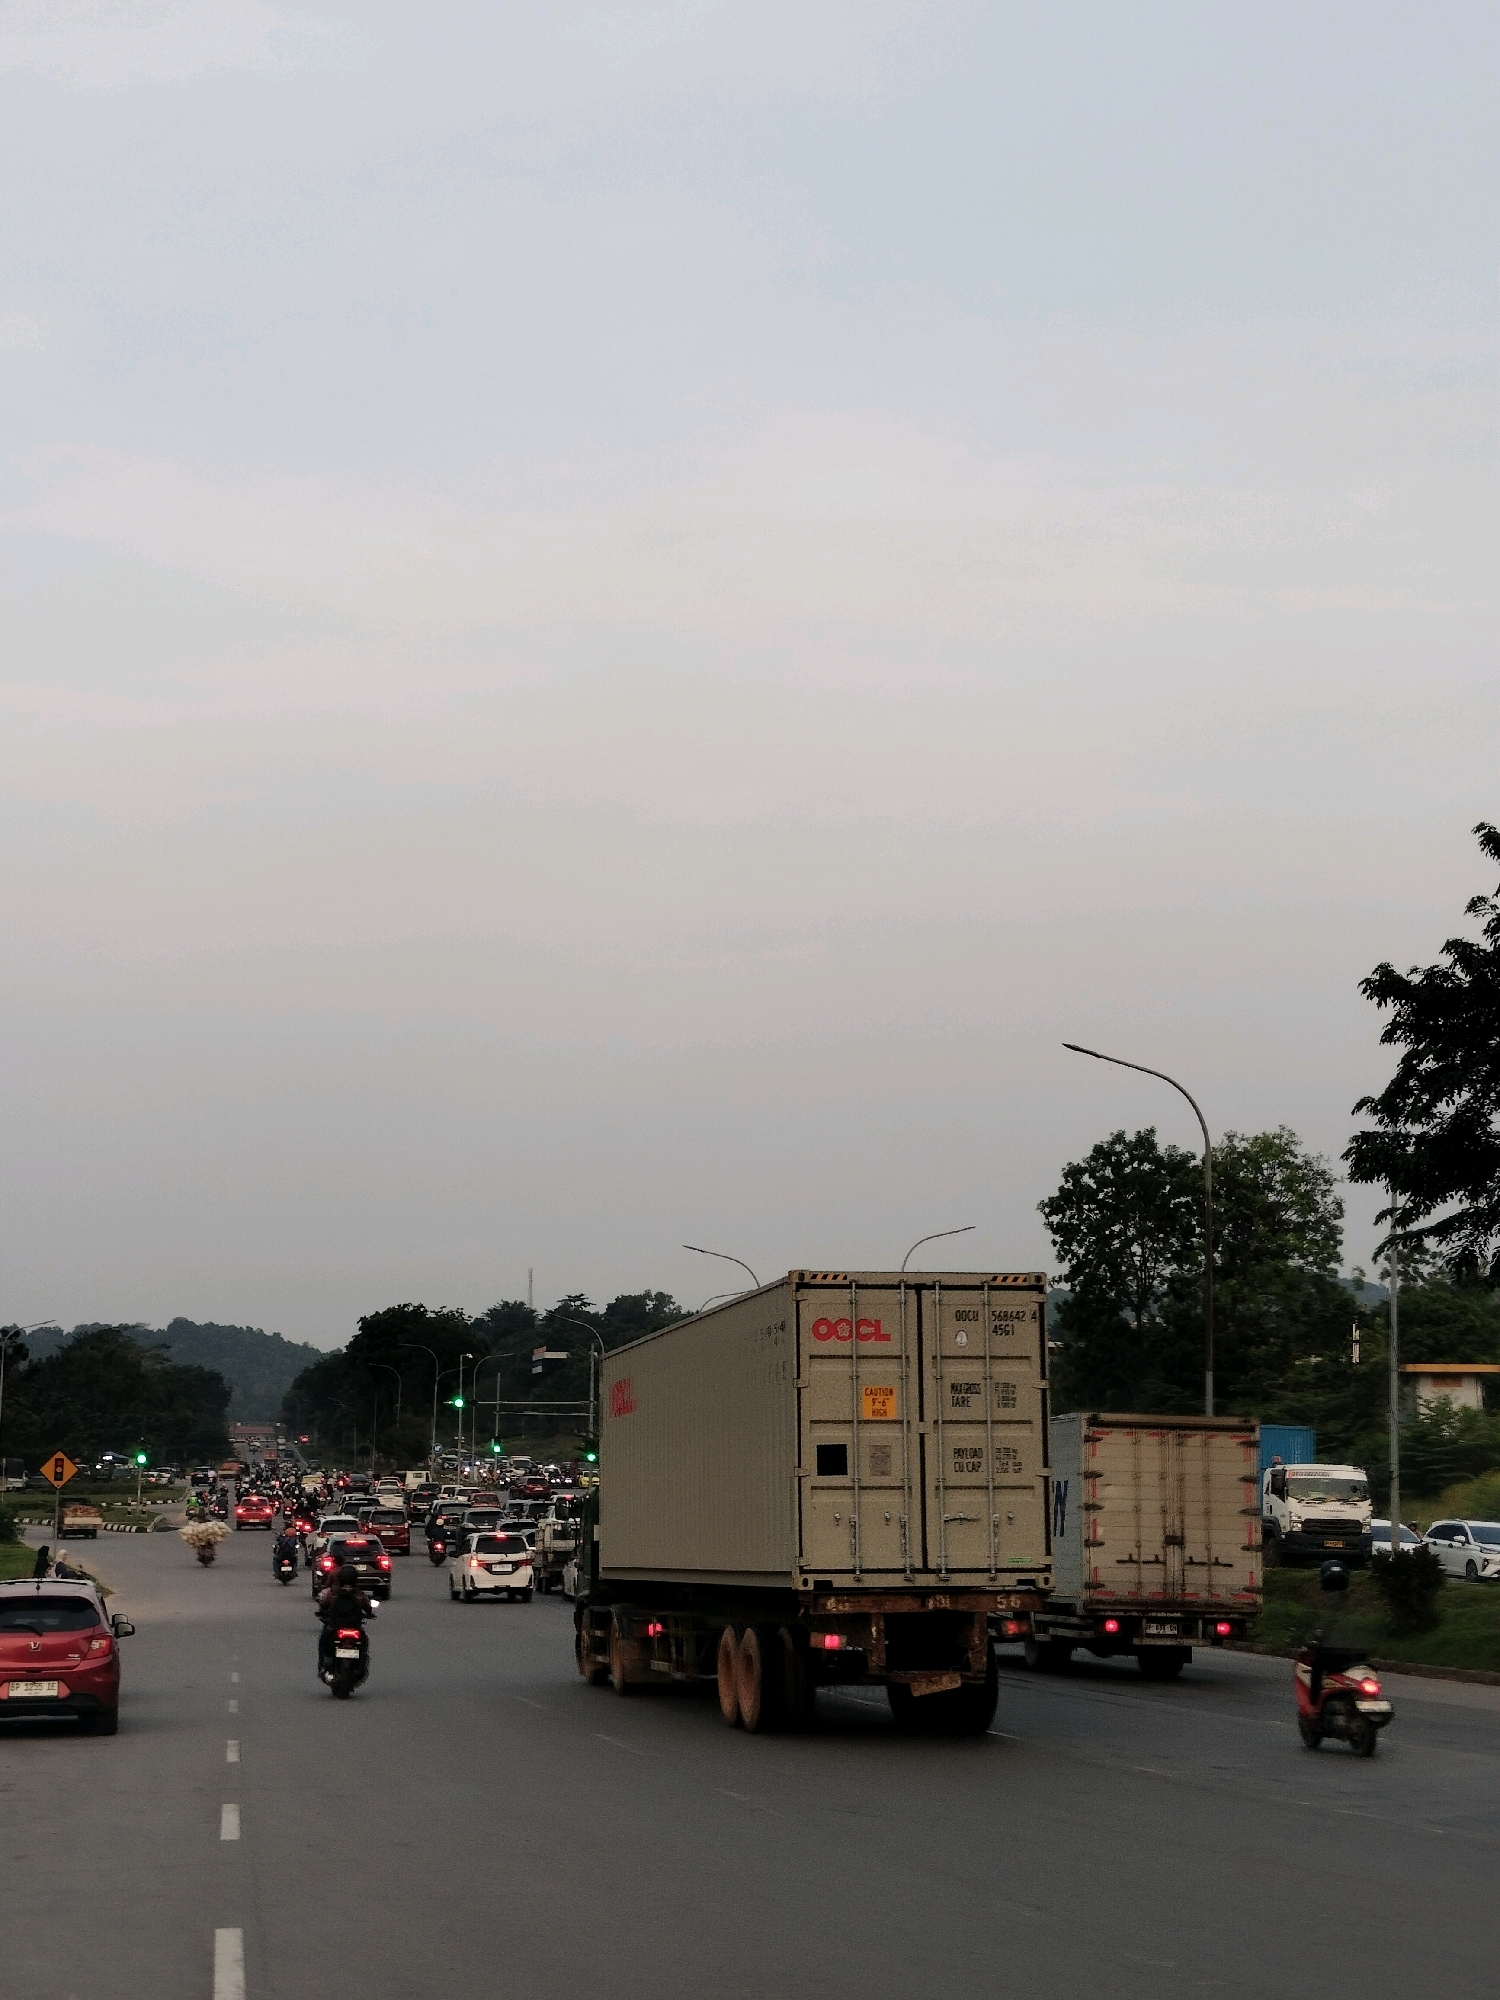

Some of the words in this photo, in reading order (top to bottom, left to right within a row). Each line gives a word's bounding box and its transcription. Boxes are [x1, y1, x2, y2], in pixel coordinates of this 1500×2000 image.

[991, 1310, 1026, 1321] 568642
[812, 1318, 891, 1342] OOCL
[992, 1324, 1015, 1336] 45G1
[865, 1388, 893, 1396] CAUTION
[951, 1396, 971, 1407] TARE
[872, 1409, 888, 1417] HIGH
[953, 1447, 983, 1459] PAYLOAD
